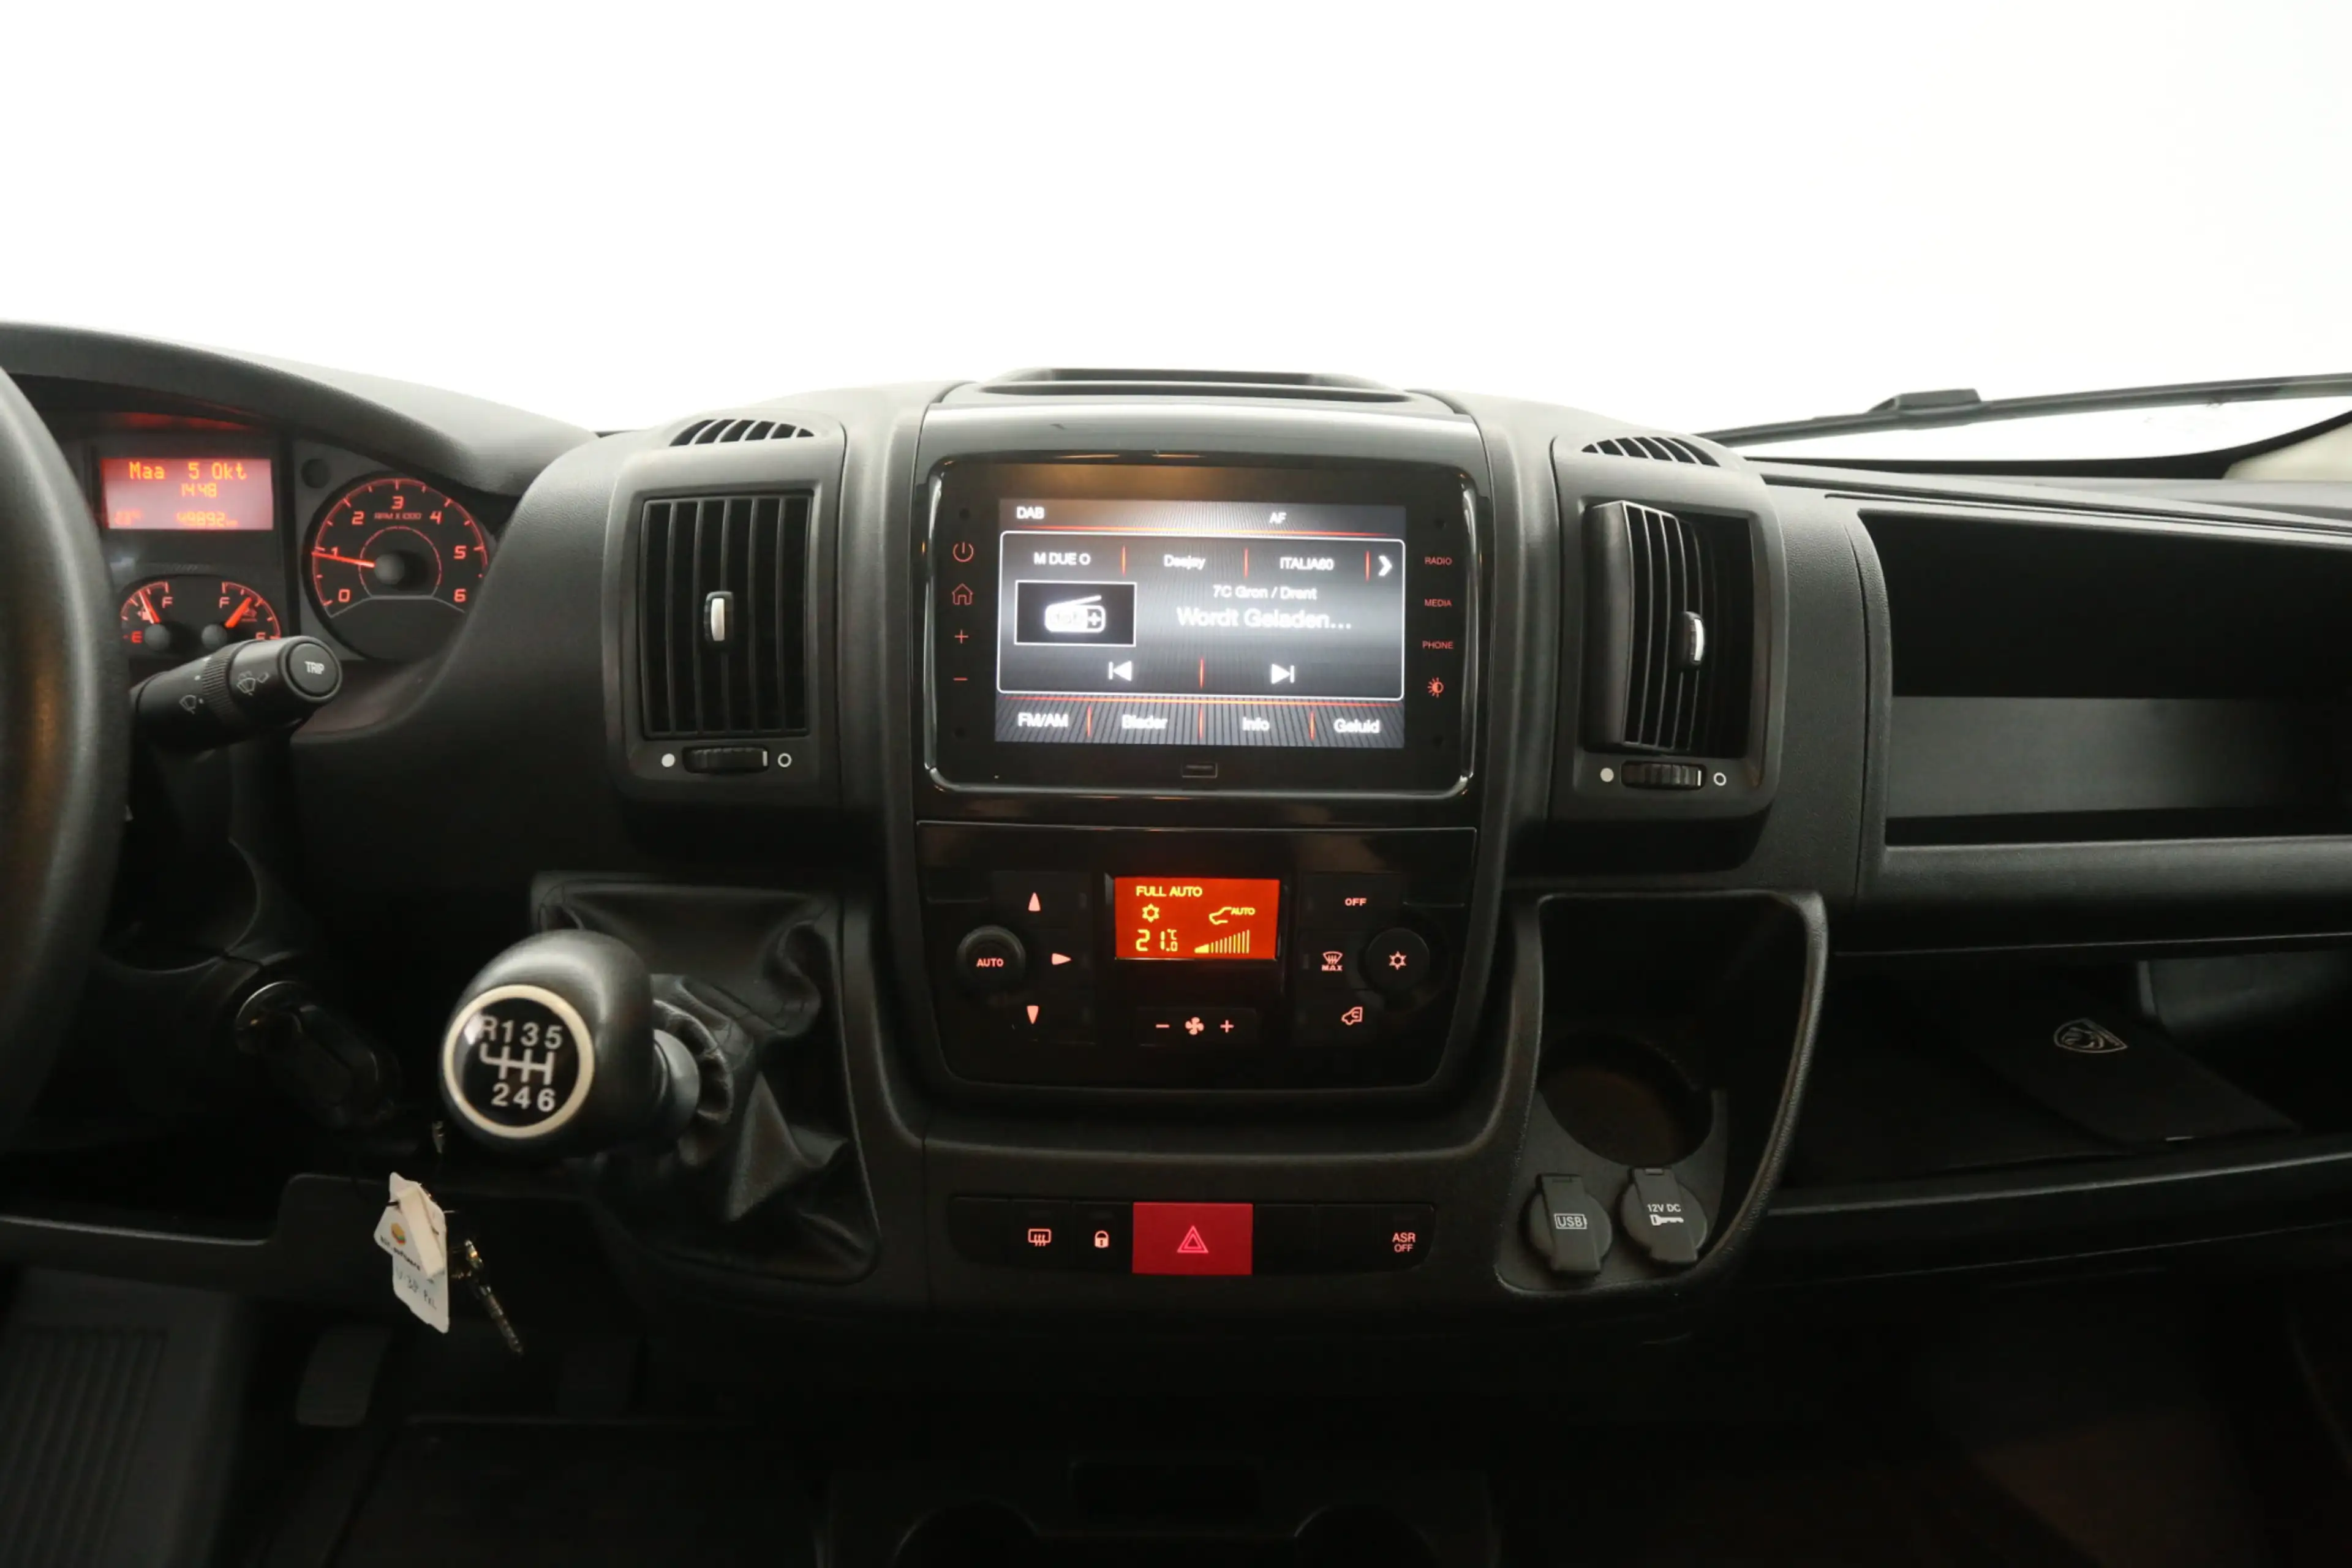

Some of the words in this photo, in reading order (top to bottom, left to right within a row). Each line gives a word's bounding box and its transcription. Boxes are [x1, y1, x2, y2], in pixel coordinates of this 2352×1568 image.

[129, 461, 165, 480] Maa
[188, 462, 199, 480] 5
[211, 462, 247, 480] Okt
[391, 496, 404, 510] 3
[351, 511, 364, 525] 2
[430, 511, 442, 525] 4
[1016, 506, 1044, 519] DAB
[1268, 512, 1286, 524] AF
[453, 545, 467, 560] 5
[1033, 552, 1046, 565] M
[1049, 552, 1076, 565] DUE
[1163, 554, 1205, 570] Deejay
[1424, 557, 1453, 566] RADIO
[338, 589, 351, 603] 0
[453, 589, 467, 603] 6
[1213, 585, 1232, 598] 7C
[1235, 586, 1268, 599] Gron
[1280, 586, 1317, 600] Drent
[162, 597, 173, 609] F
[219, 597, 230, 609] F
[1424, 598, 1453, 608] MEDIA
[1176, 606, 1238, 627] Wordt
[130, 631, 143, 644] E
[1422, 640, 1454, 649] PHONE
[304, 660, 325, 675] TRIP
[1017, 712, 1069, 728] FM/AM
[1242, 716, 1270, 732] Info
[1333, 718, 1381, 734] Geluid
[1136, 886, 1166, 897] FULL
[1169, 886, 1203, 897] AUTO
[1344, 898, 1367, 907] OFF
[1230, 907, 1256, 916] AUTO
[976, 958, 1005, 968] AUTO
[1648, 1204, 1664, 1213] 12V
[1667, 1204, 1682, 1213] DC
[1556, 1216, 1583, 1227] USB
[1392, 1232, 1416, 1243] ASR
[1393, 1243, 1414, 1253] OFF
